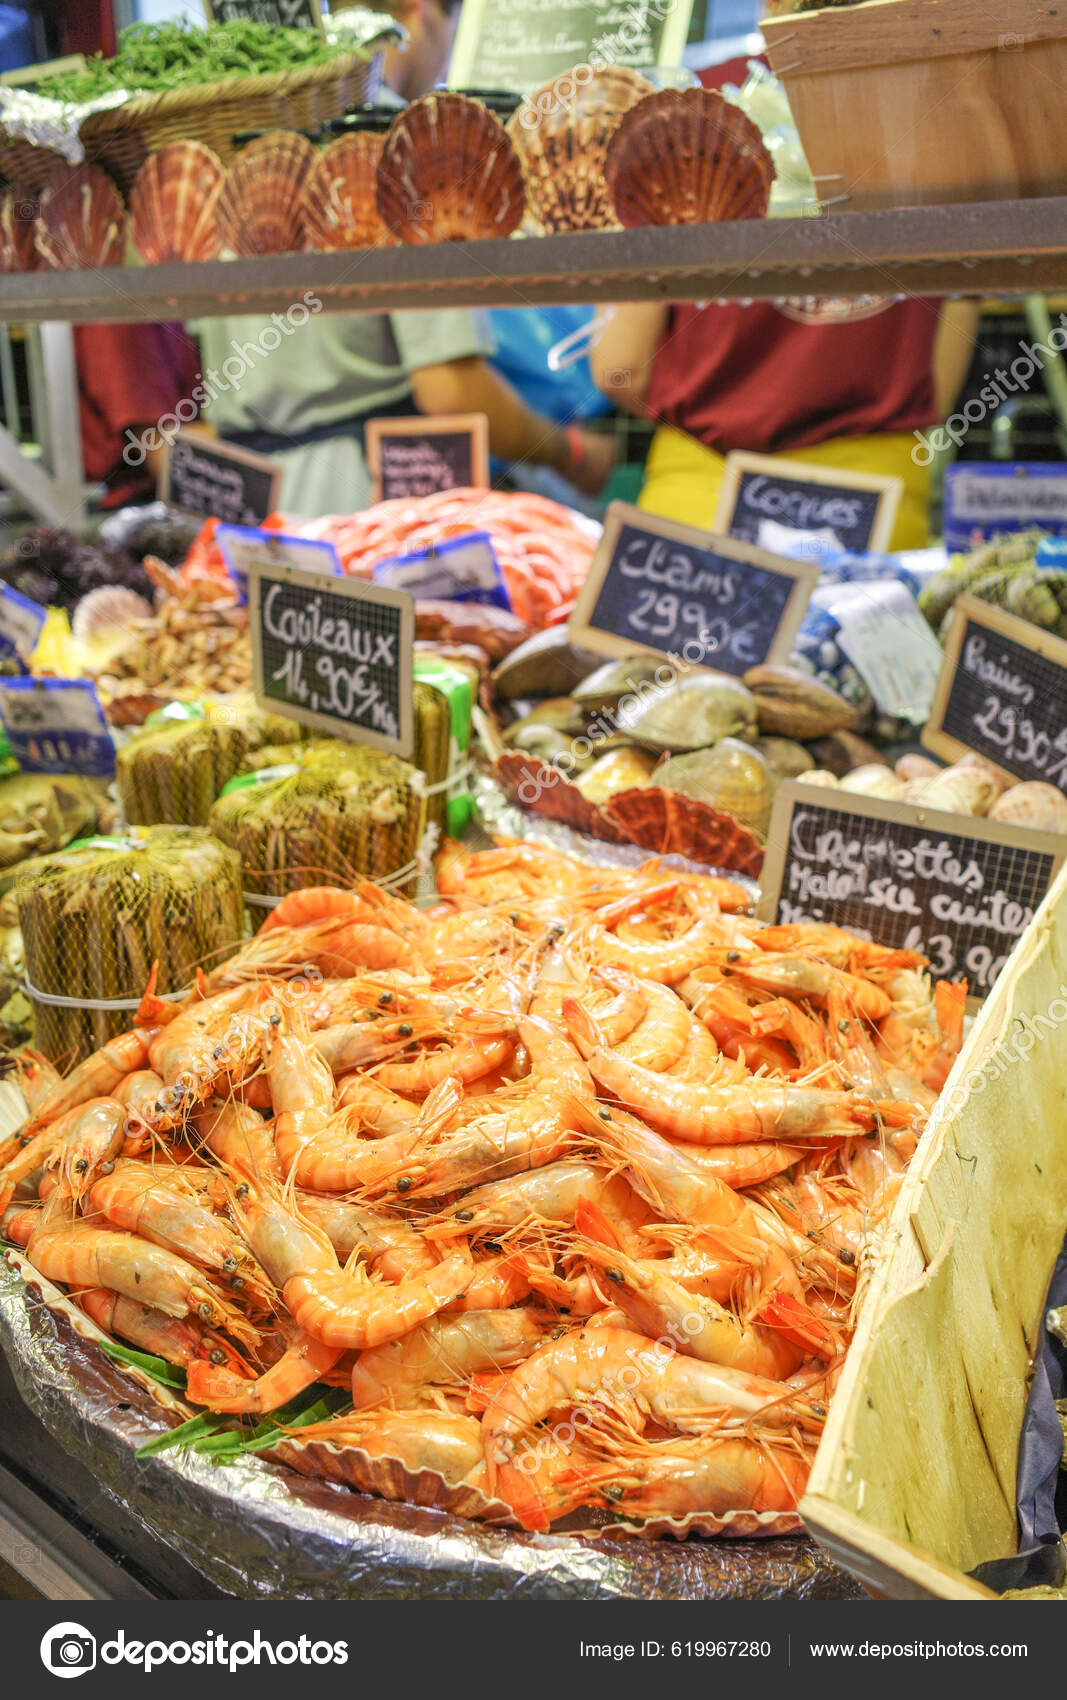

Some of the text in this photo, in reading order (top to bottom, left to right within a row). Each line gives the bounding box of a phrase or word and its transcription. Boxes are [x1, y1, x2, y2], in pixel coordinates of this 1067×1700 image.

[743, 475, 863, 529] Coques
[619, 539, 742, 605] Clams
[264, 583, 395, 667] Couteaux
